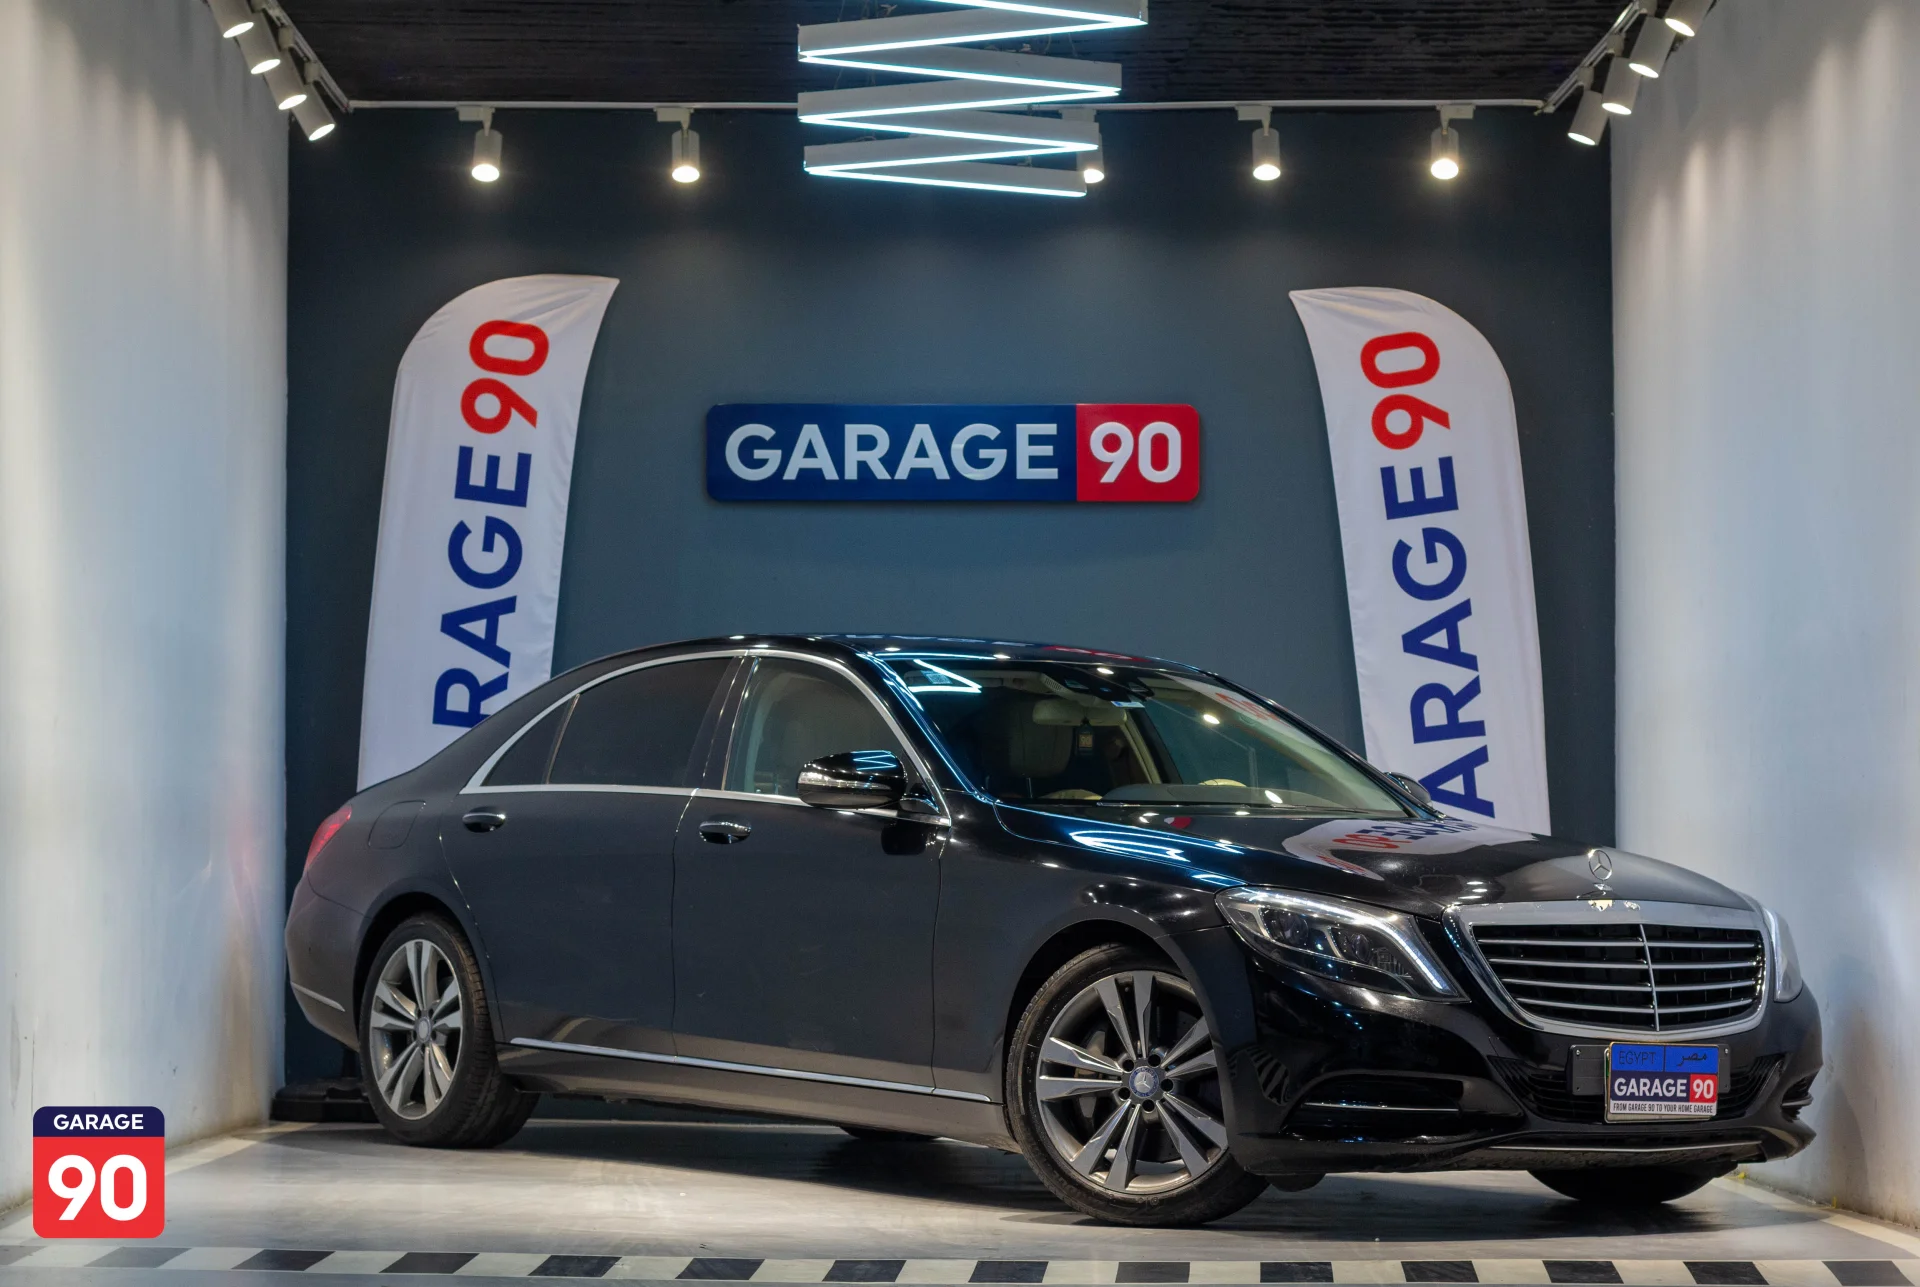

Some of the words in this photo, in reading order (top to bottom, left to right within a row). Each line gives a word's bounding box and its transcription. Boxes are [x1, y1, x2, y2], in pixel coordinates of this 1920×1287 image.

[725, 423, 1058, 481] GARAGE
[1090, 421, 1182, 483] 90
[1619, 1051, 1656, 1065] EGYPT
[1677, 1053, 1708, 1067] مصر
[1614, 1078, 1687, 1097] GARAGE
[1693, 1079, 1714, 1099] 90
[1613, 1103, 1627, 1111] FROM
[1628, 1103, 1647, 1112] GARAGE
[1648, 1103, 1655, 1112] 90
[1656, 1104, 1663, 1112] TO
[1664, 1104, 1677, 1112] YOUR
[1678, 1104, 1692, 1113] HOME
[1693, 1105, 1713, 1113] GARAGE
